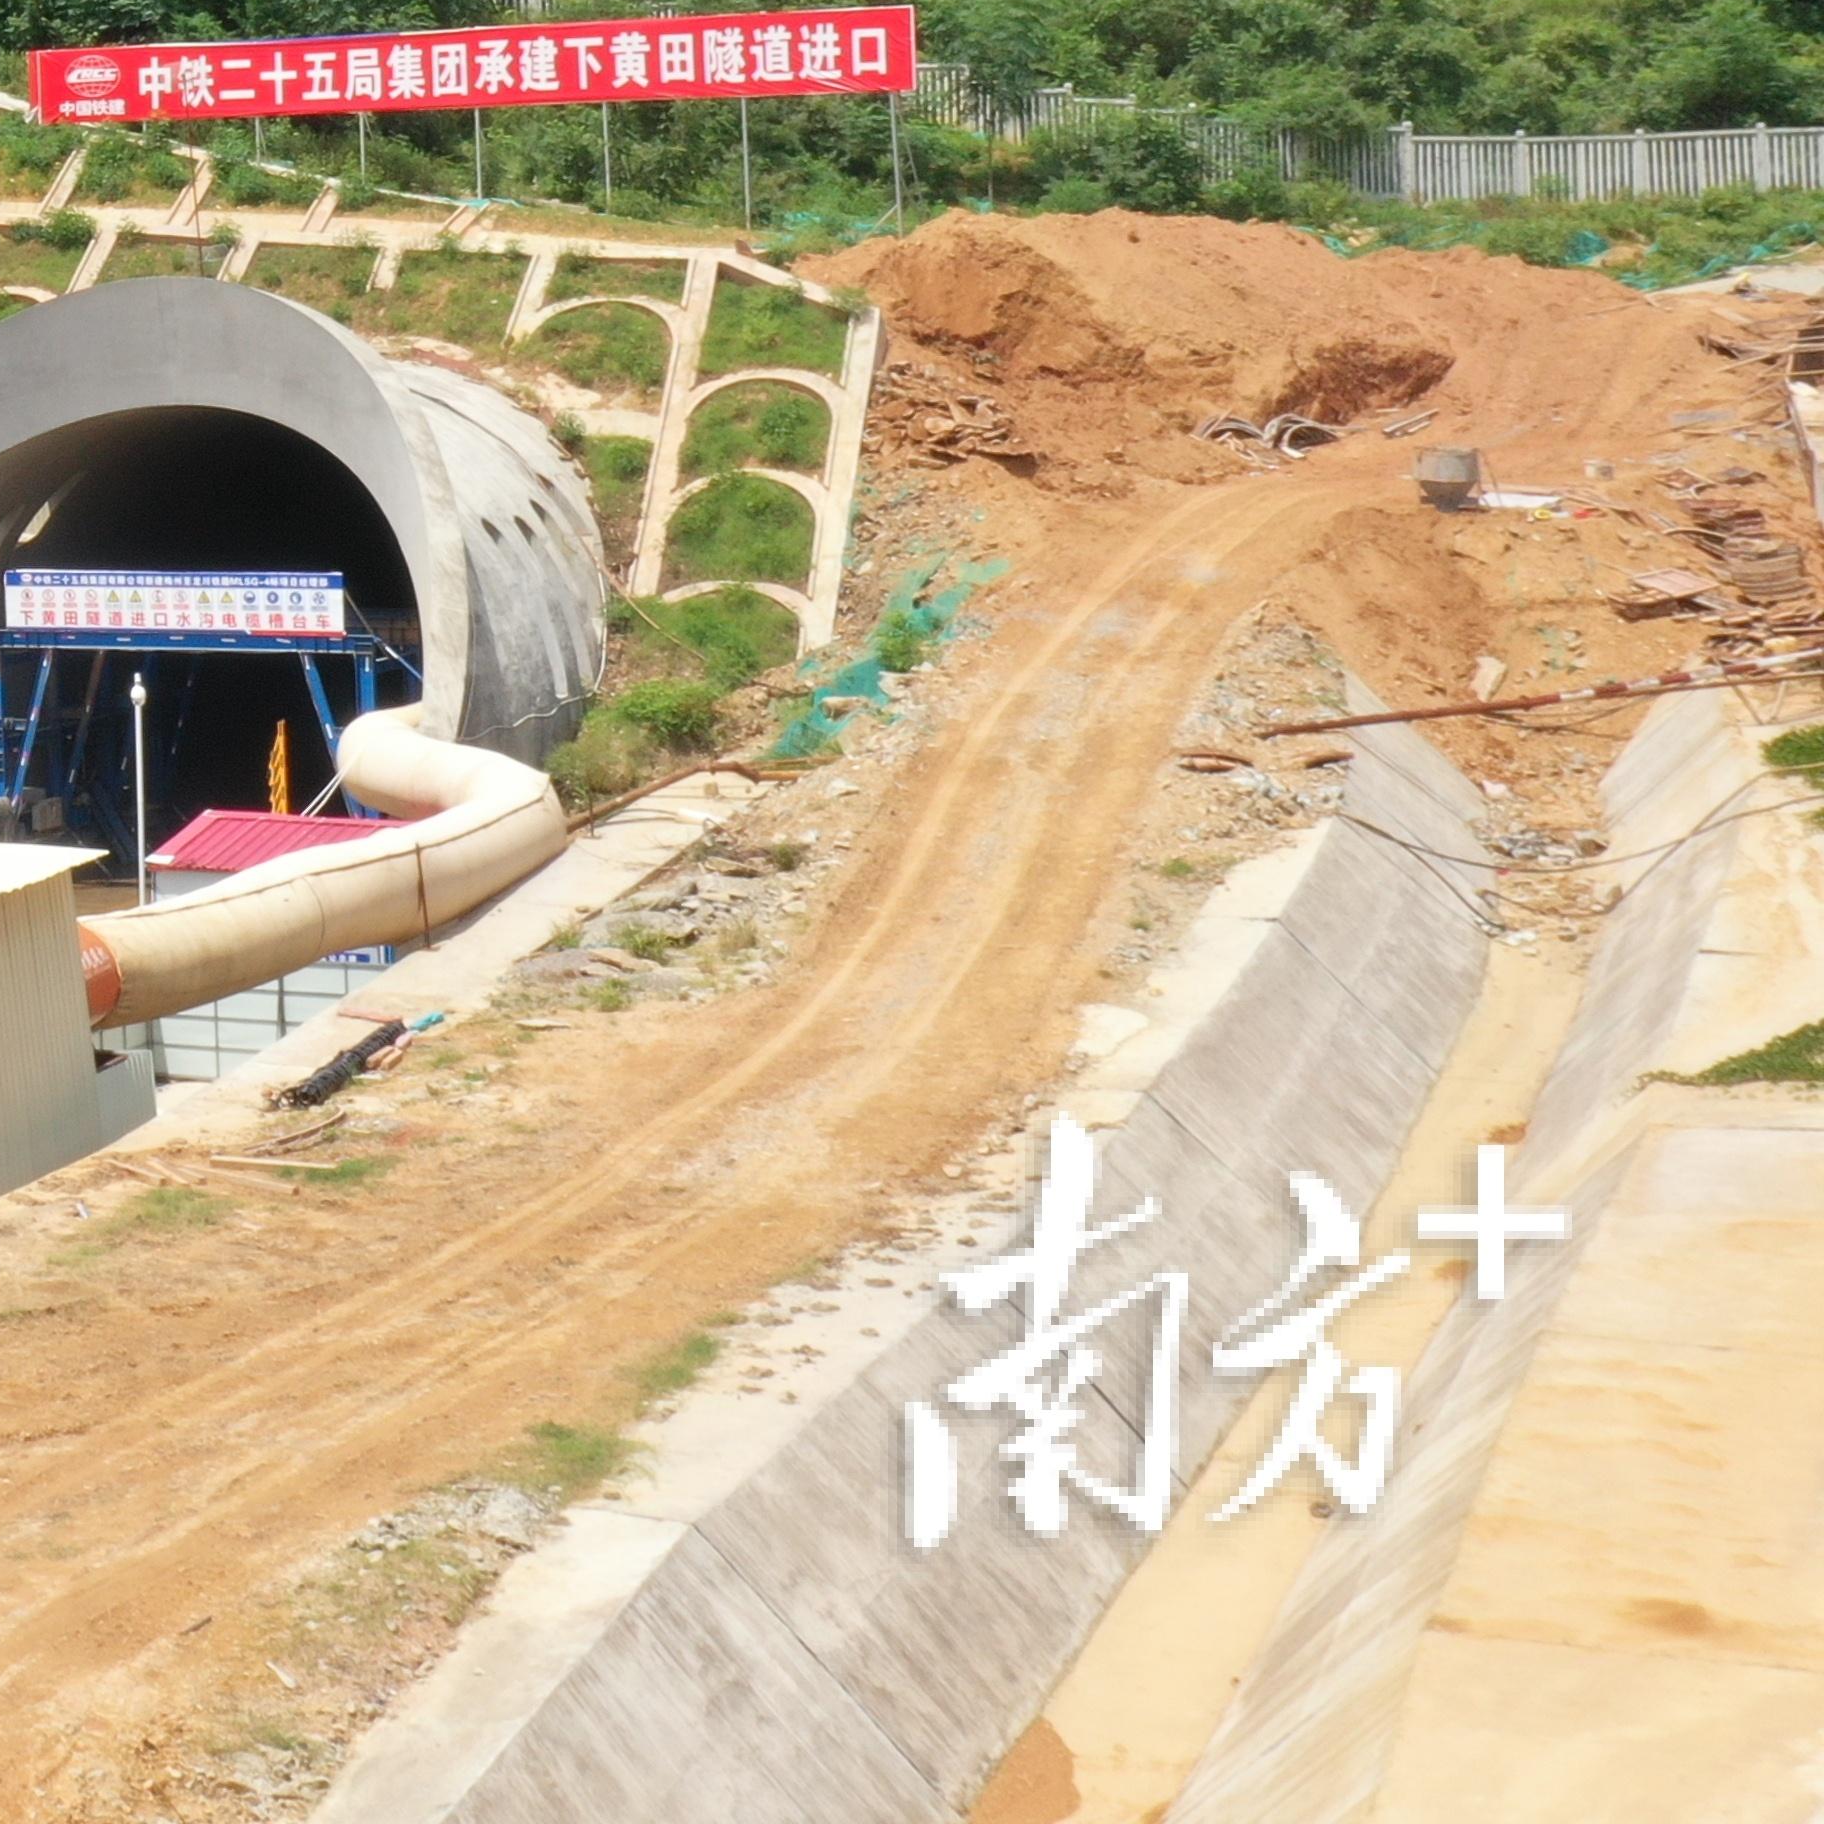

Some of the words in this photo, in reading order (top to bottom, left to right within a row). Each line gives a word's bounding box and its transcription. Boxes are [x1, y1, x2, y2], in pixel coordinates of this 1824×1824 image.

[138, 27, 890, 111] 中铁二十五局集团承建下黄田隧道进口
[58, 98, 126, 117] 中国铁建
[20, 610, 331, 628] 下黄田隧道进口水沟电缆槽台车
